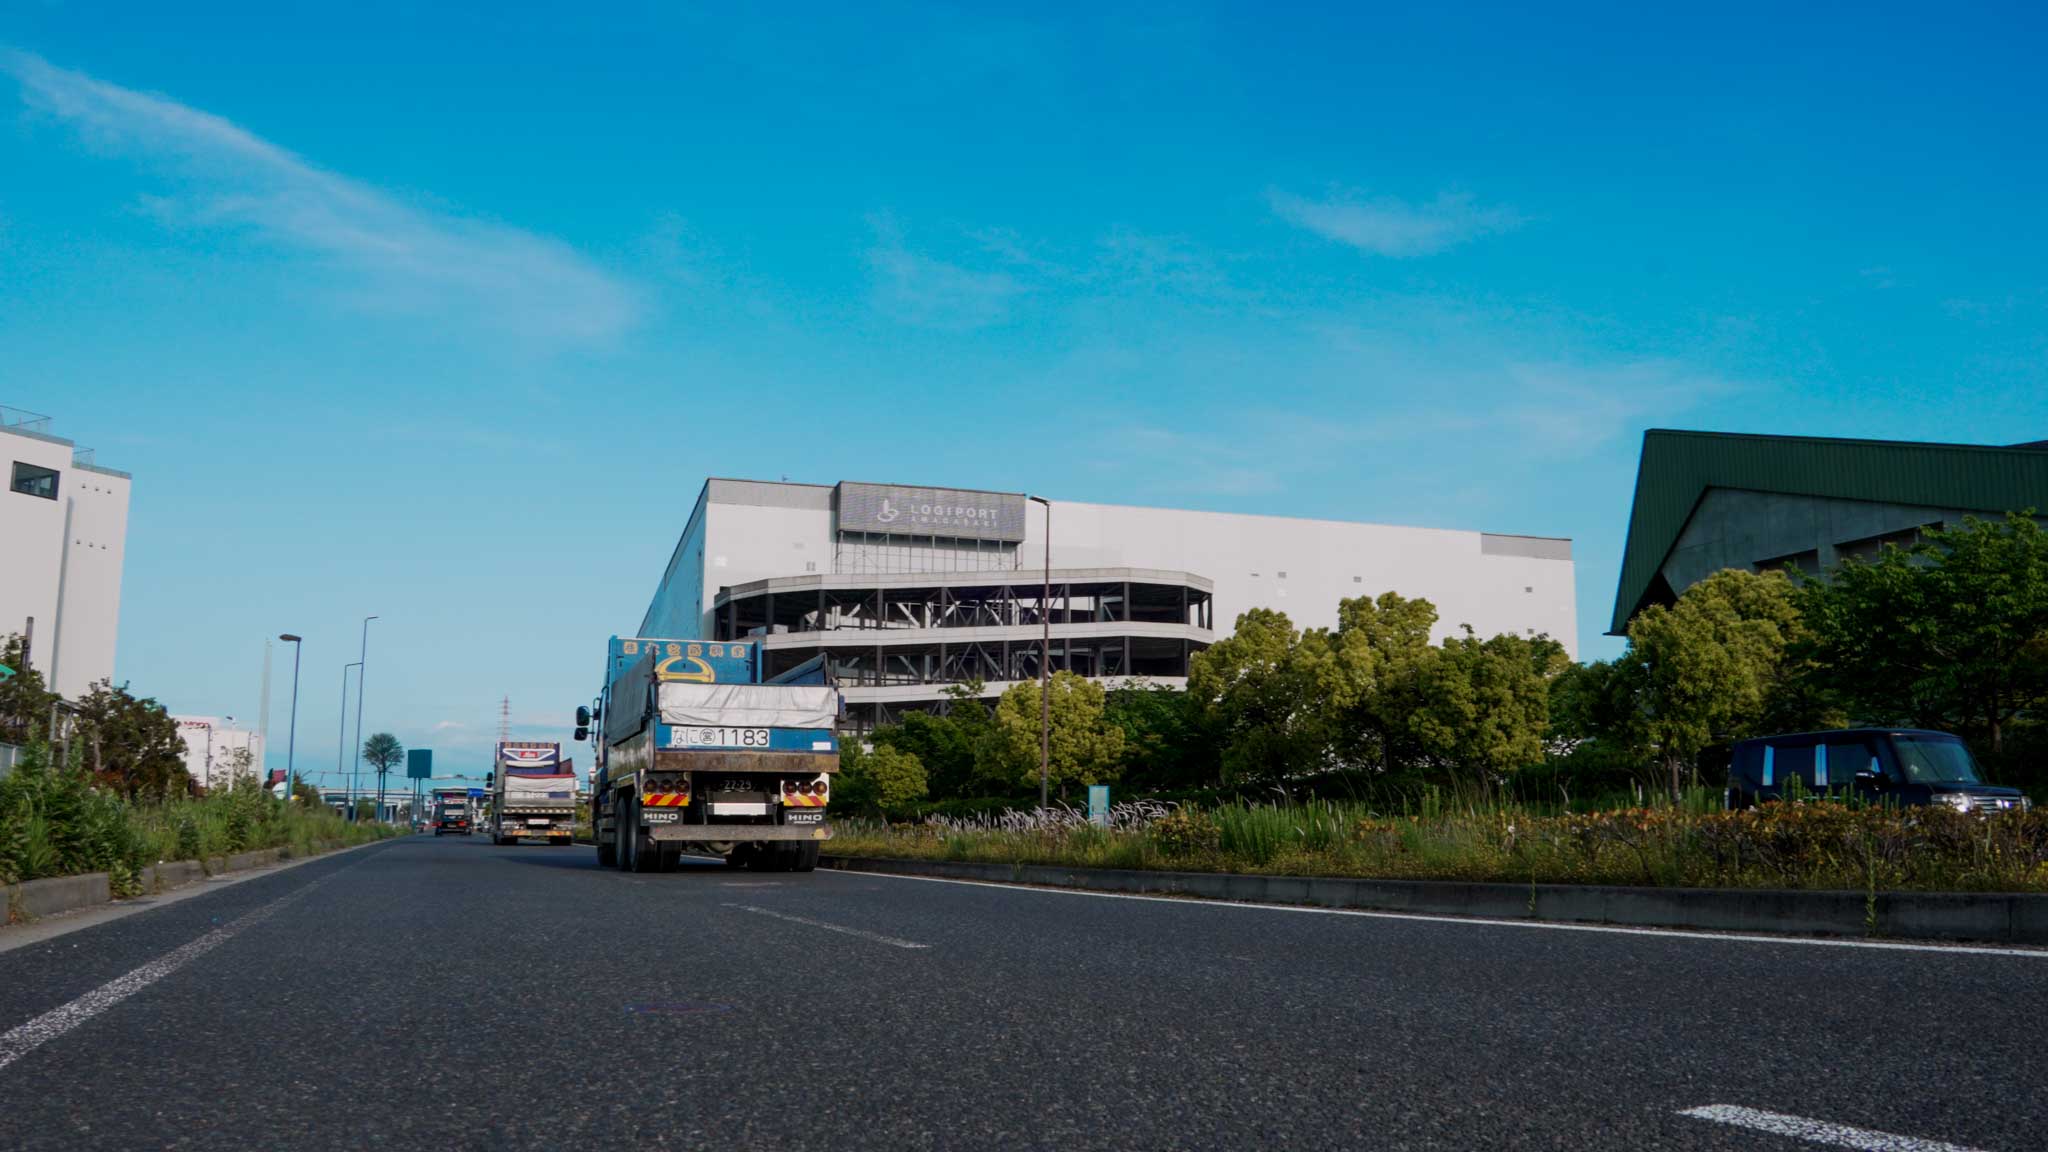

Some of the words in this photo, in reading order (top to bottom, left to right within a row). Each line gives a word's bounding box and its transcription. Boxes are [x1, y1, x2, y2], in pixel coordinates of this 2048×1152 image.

[911, 504, 998, 519] LOGIPORT
[643, 812, 679, 820] HINO
[788, 813, 823, 821] HINO
